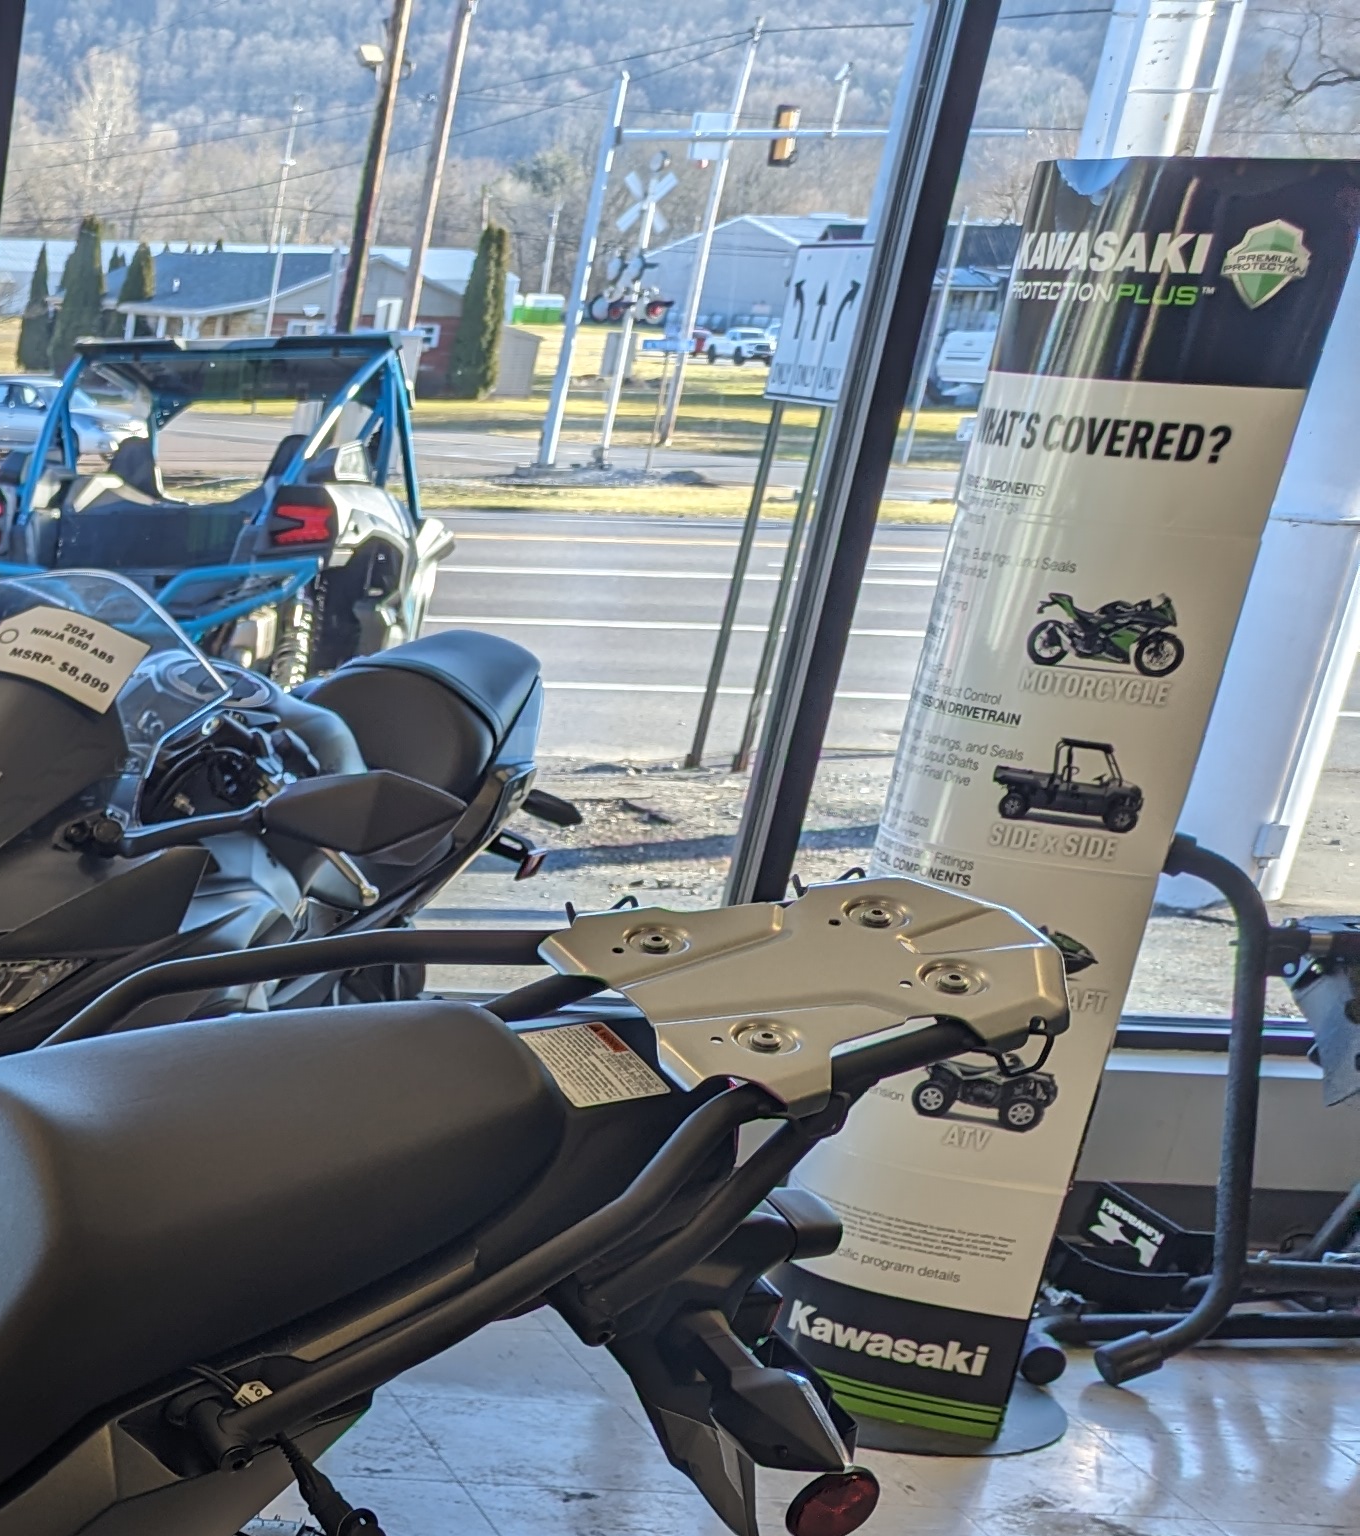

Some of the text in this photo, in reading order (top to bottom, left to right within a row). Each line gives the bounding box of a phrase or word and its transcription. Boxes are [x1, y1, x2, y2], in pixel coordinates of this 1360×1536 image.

[1017, 231, 1215, 275] KAWASAKI
[1237, 253, 1298, 265] PREMIUM
[1223, 262, 1306, 275] PROTECTION
[1012, 281, 1114, 302] PROTECTION
[977, 407, 1233, 464] WHAT'S COVERED?
[1041, 557, 1077, 573] Seals
[63, 623, 95, 641] 2024
[30, 627, 115, 665] NINJA 650 ABS
[58, 661, 110, 694] $8,899
[1019, 667, 1171, 706] MOTORCYCLE
[963, 687, 1003, 705] Control
[948, 701, 1022, 727] DRIVETRAIN
[946, 754, 979, 771] Shafts
[965, 742, 988, 755] and
[989, 745, 1024, 761] Seals
[943, 770, 971, 786] Drive
[988, 822, 1039, 852] SIDE
[1064, 833, 1120, 862] SIDE
[893, 856, 972, 887] COMPONENTS
[935, 851, 974, 872] Fittings
[942, 1125, 993, 1150] ATV
[861, 1254, 914, 1274] program
[918, 1265, 961, 1284] details
[787, 1299, 990, 1376] Kawasaki
